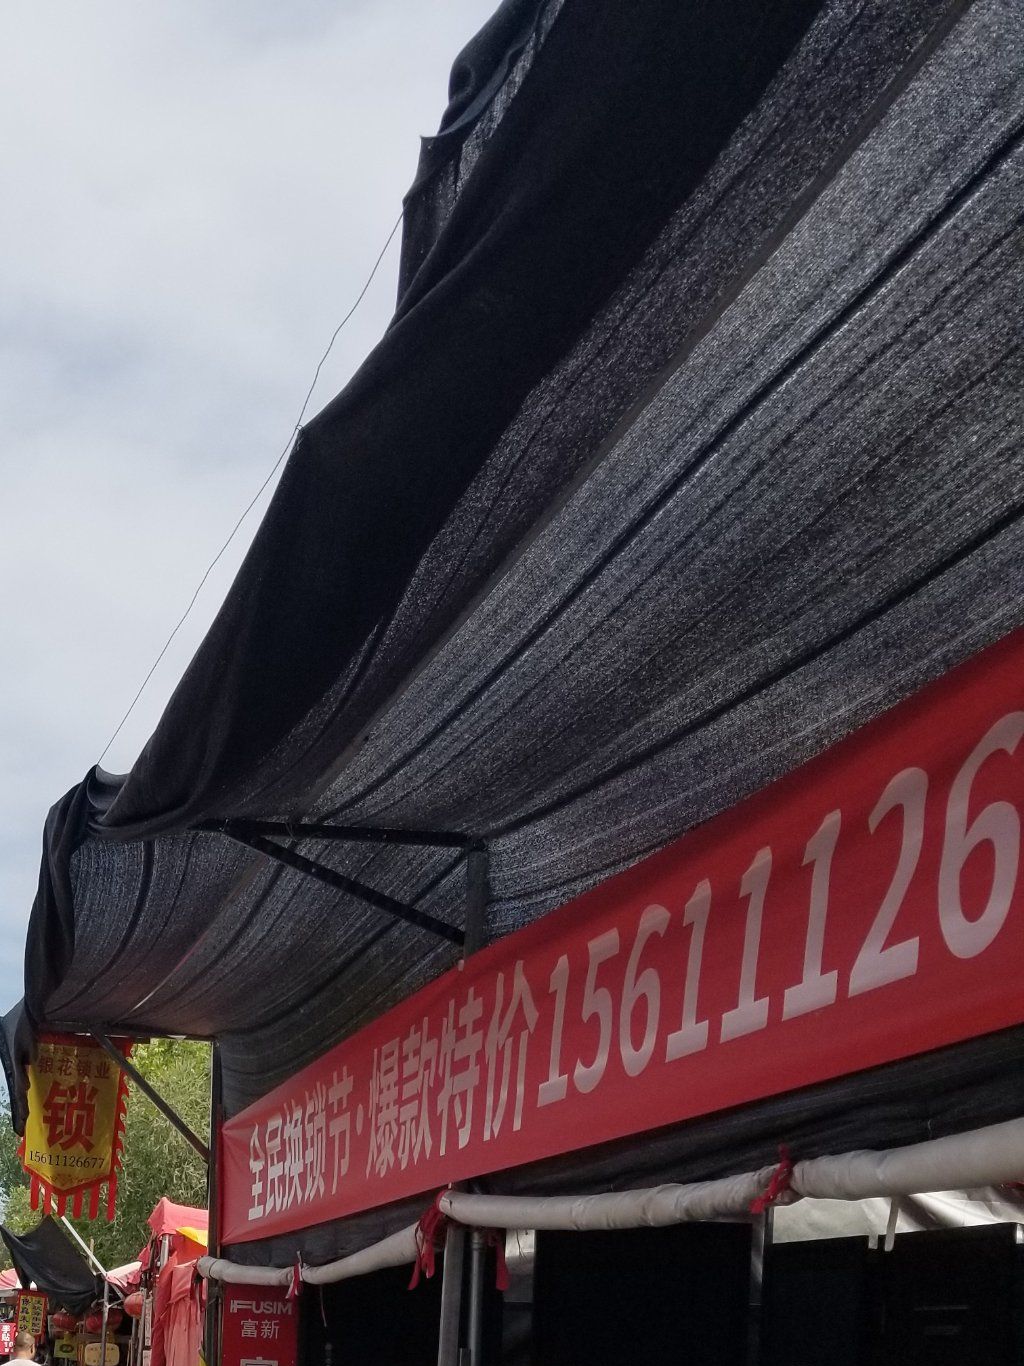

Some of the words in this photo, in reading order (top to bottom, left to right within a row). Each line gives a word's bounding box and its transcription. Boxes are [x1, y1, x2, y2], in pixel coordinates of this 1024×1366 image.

[42, 1081, 99, 1153] 锁
[29, 1149, 105, 1169] 15611126677
[240, 1318, 280, 1339] 富新
